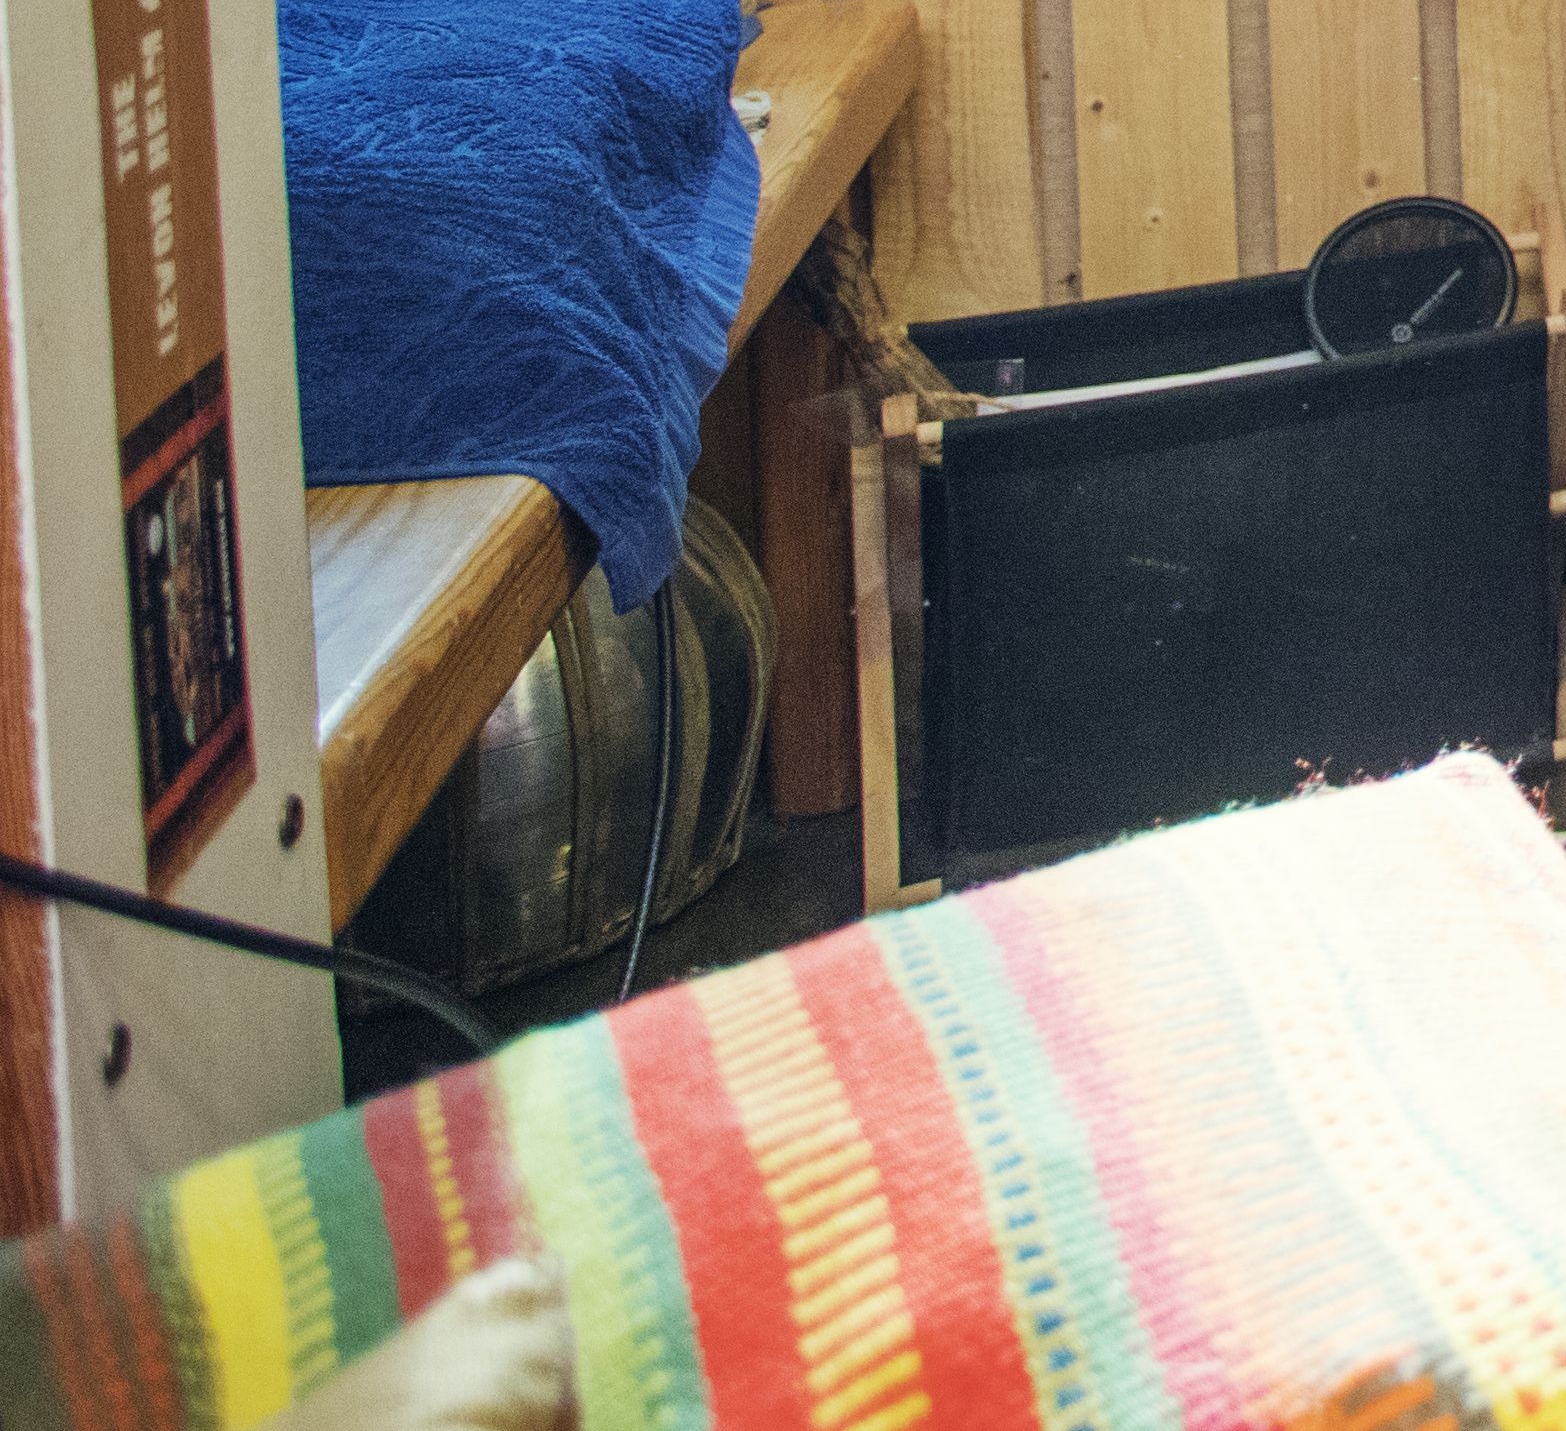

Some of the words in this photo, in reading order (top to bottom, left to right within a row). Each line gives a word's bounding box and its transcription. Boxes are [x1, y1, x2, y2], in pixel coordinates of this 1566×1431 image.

[112, 74, 139, 183] THE
[140, 28, 171, 172] HELM
[148, 184, 180, 357] LEVON
